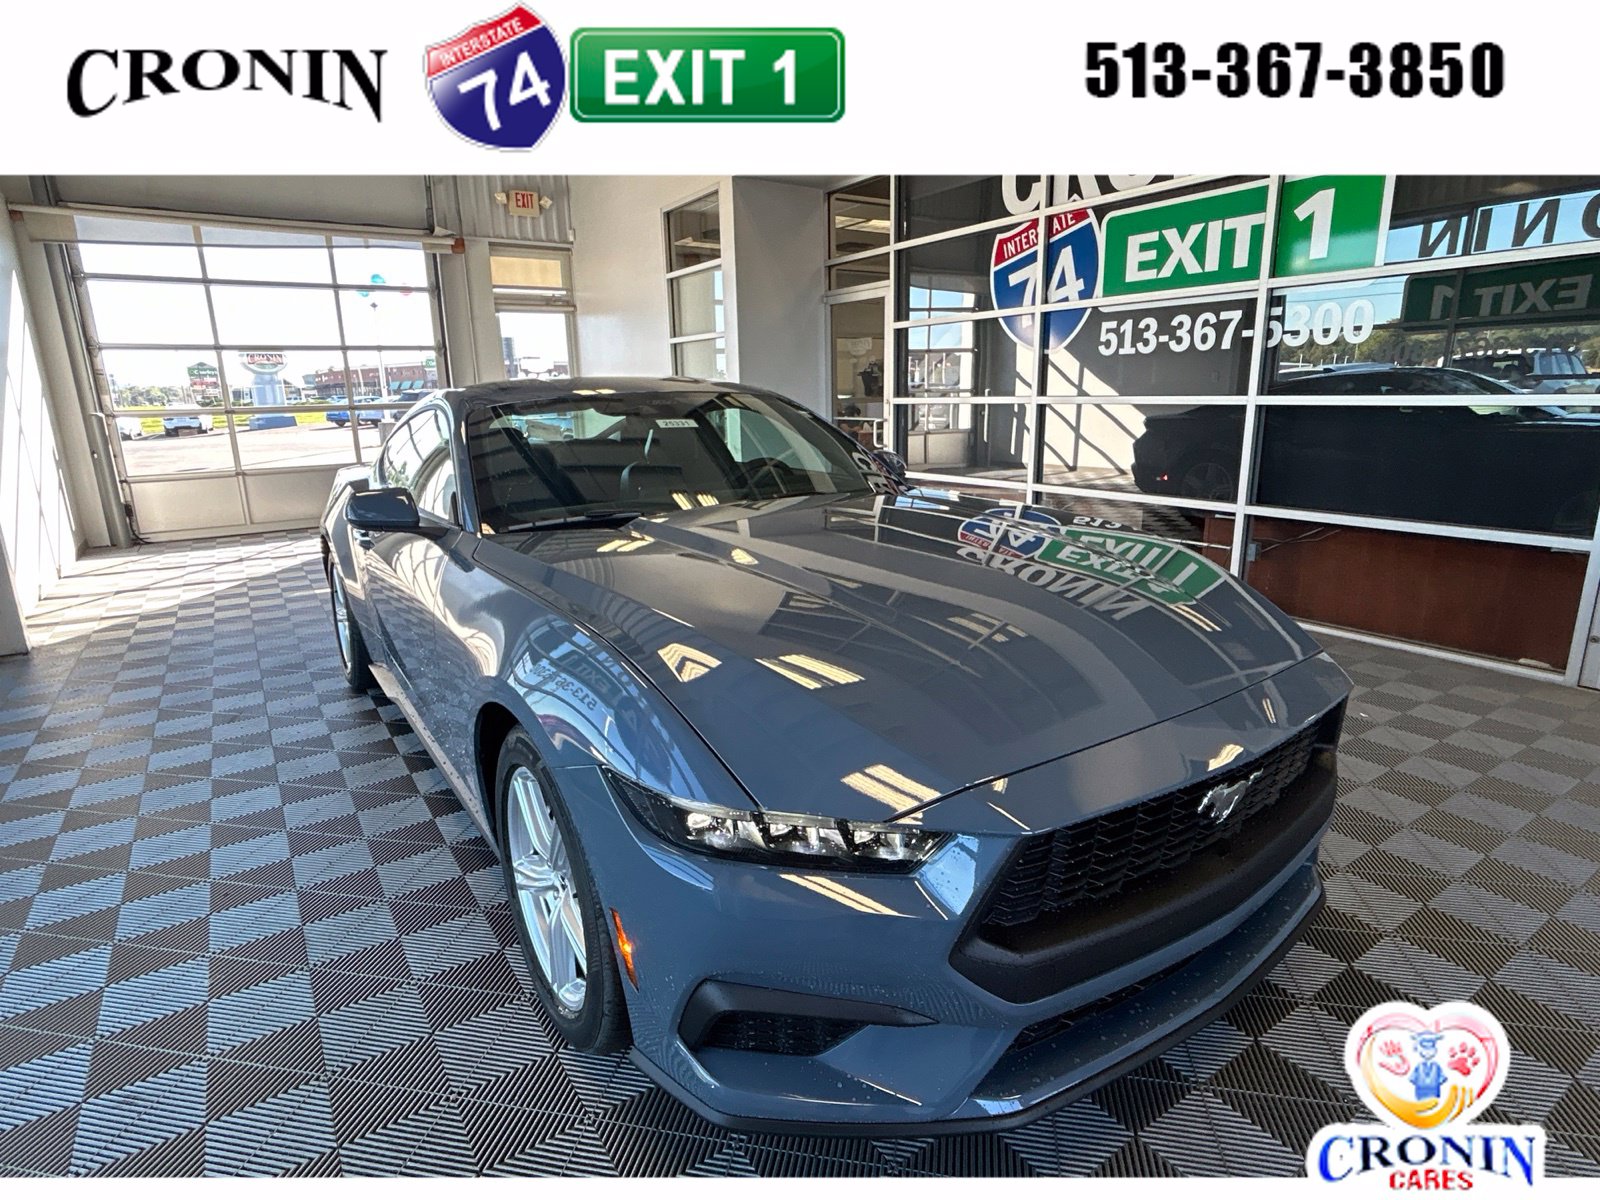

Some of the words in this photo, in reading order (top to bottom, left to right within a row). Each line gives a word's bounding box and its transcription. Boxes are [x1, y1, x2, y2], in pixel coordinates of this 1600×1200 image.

[514, 192, 534, 209] EXIT
[1125, 212, 1266, 283] EXIT
[1293, 187, 1336, 261] 1
[1008, 245, 1085, 328] 74
